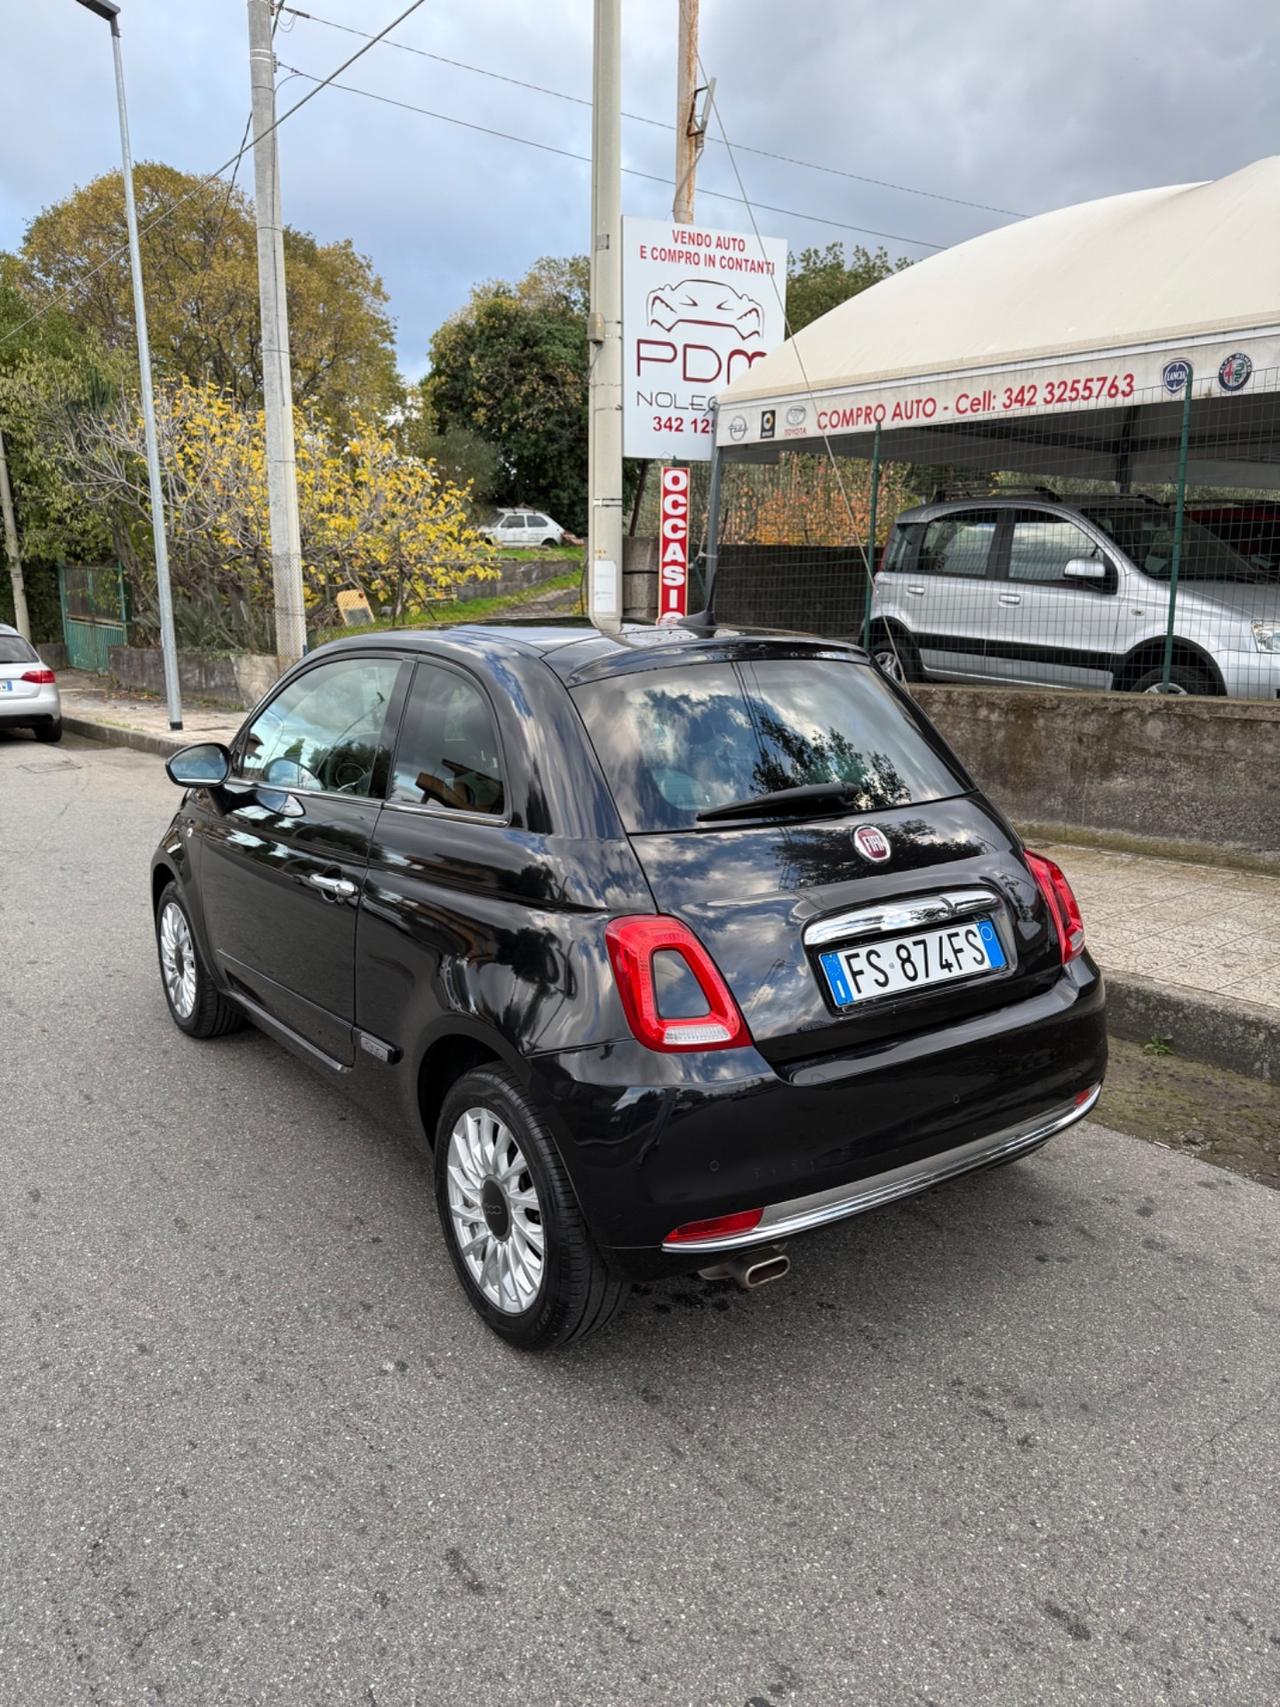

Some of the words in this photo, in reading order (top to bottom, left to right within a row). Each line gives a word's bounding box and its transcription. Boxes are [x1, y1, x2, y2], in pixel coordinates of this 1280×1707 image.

[672, 229, 712, 248] VENDO
[715, 235, 746, 252] AUTO
[640, 245, 647, 259] E
[651, 247, 700, 267] COMPRO
[704, 254, 716, 268] IN
[719, 257, 775, 276] CONTANTI
[817, 404, 886, 430] COMPRO
[891, 398, 936, 422] AUTO
[955, 390, 996, 415] Cell:
[1003, 384, 1037, 410] 342
[1043, 373, 1134, 405] 3255763
[653, 416, 684, 433] 342
[844, 949, 889, 994] FS
